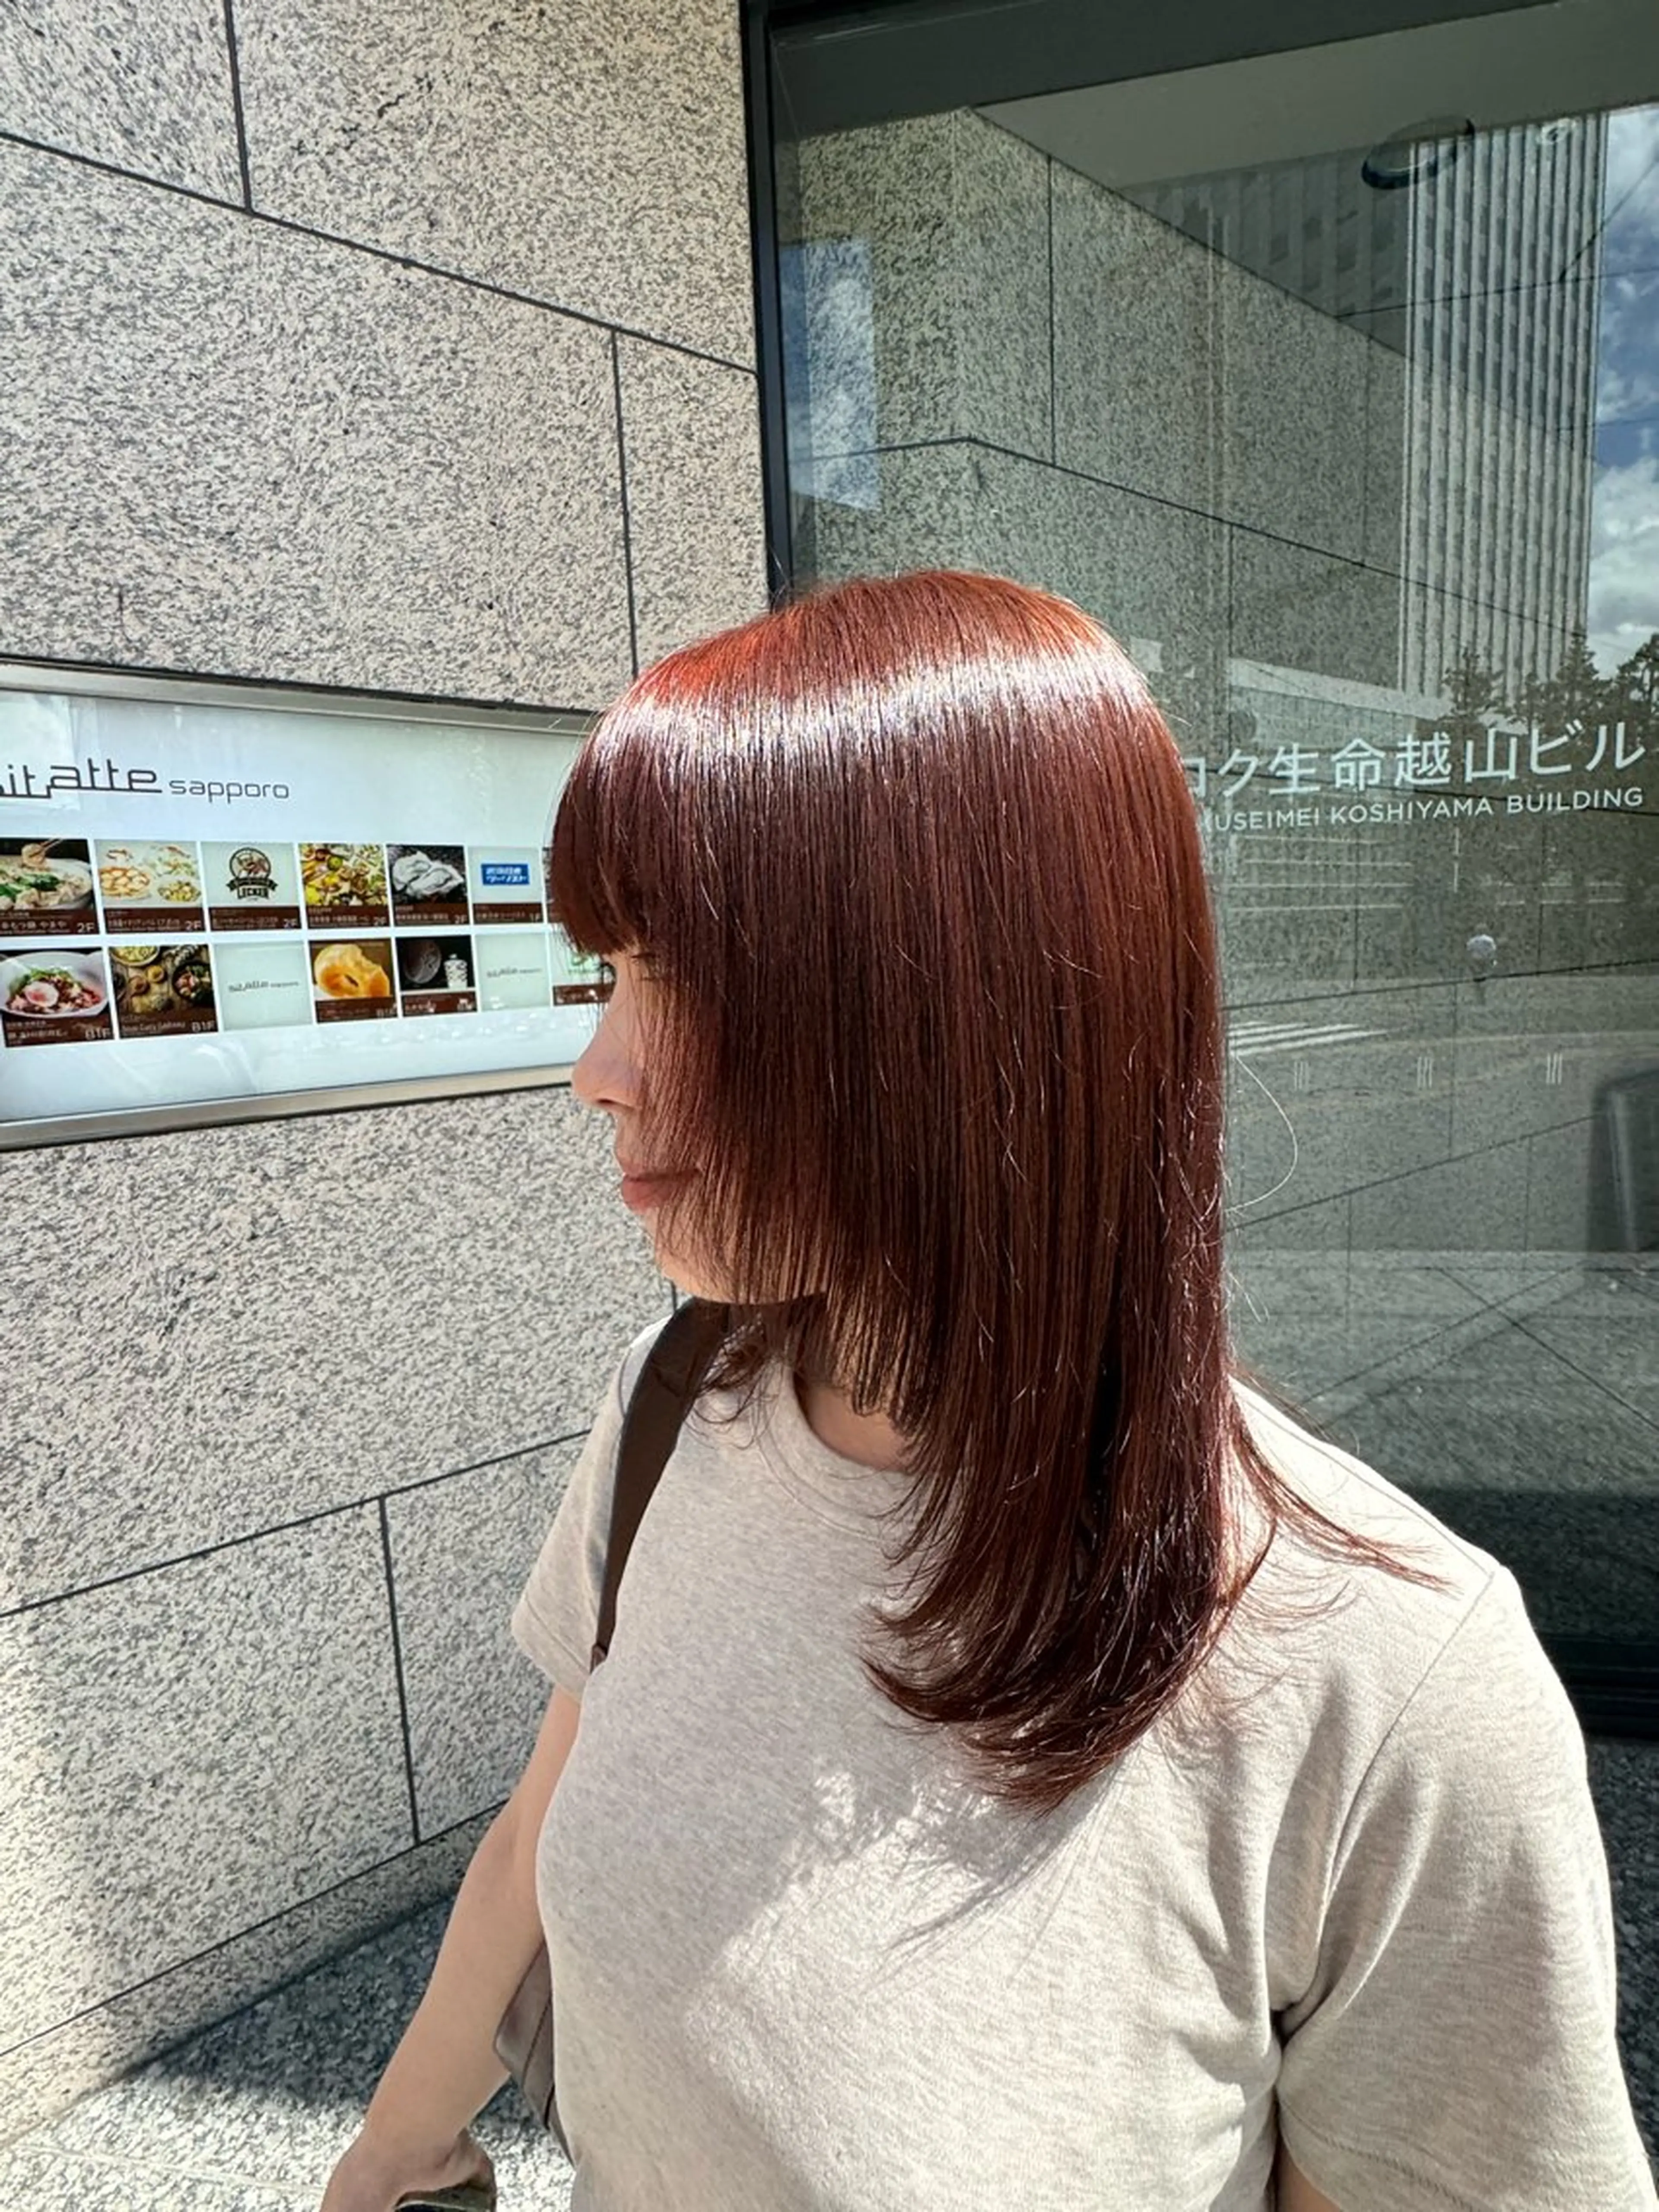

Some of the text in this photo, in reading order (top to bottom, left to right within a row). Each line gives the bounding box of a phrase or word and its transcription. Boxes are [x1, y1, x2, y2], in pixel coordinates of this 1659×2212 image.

[0, 758, 289, 804] itatte sapporo
[1331, 798, 1494, 824] KOSHIYAMA
[1507, 787, 1642, 814] BUILDING
[77, 922, 94, 933] 2F
[185, 920, 202, 930] 2F
